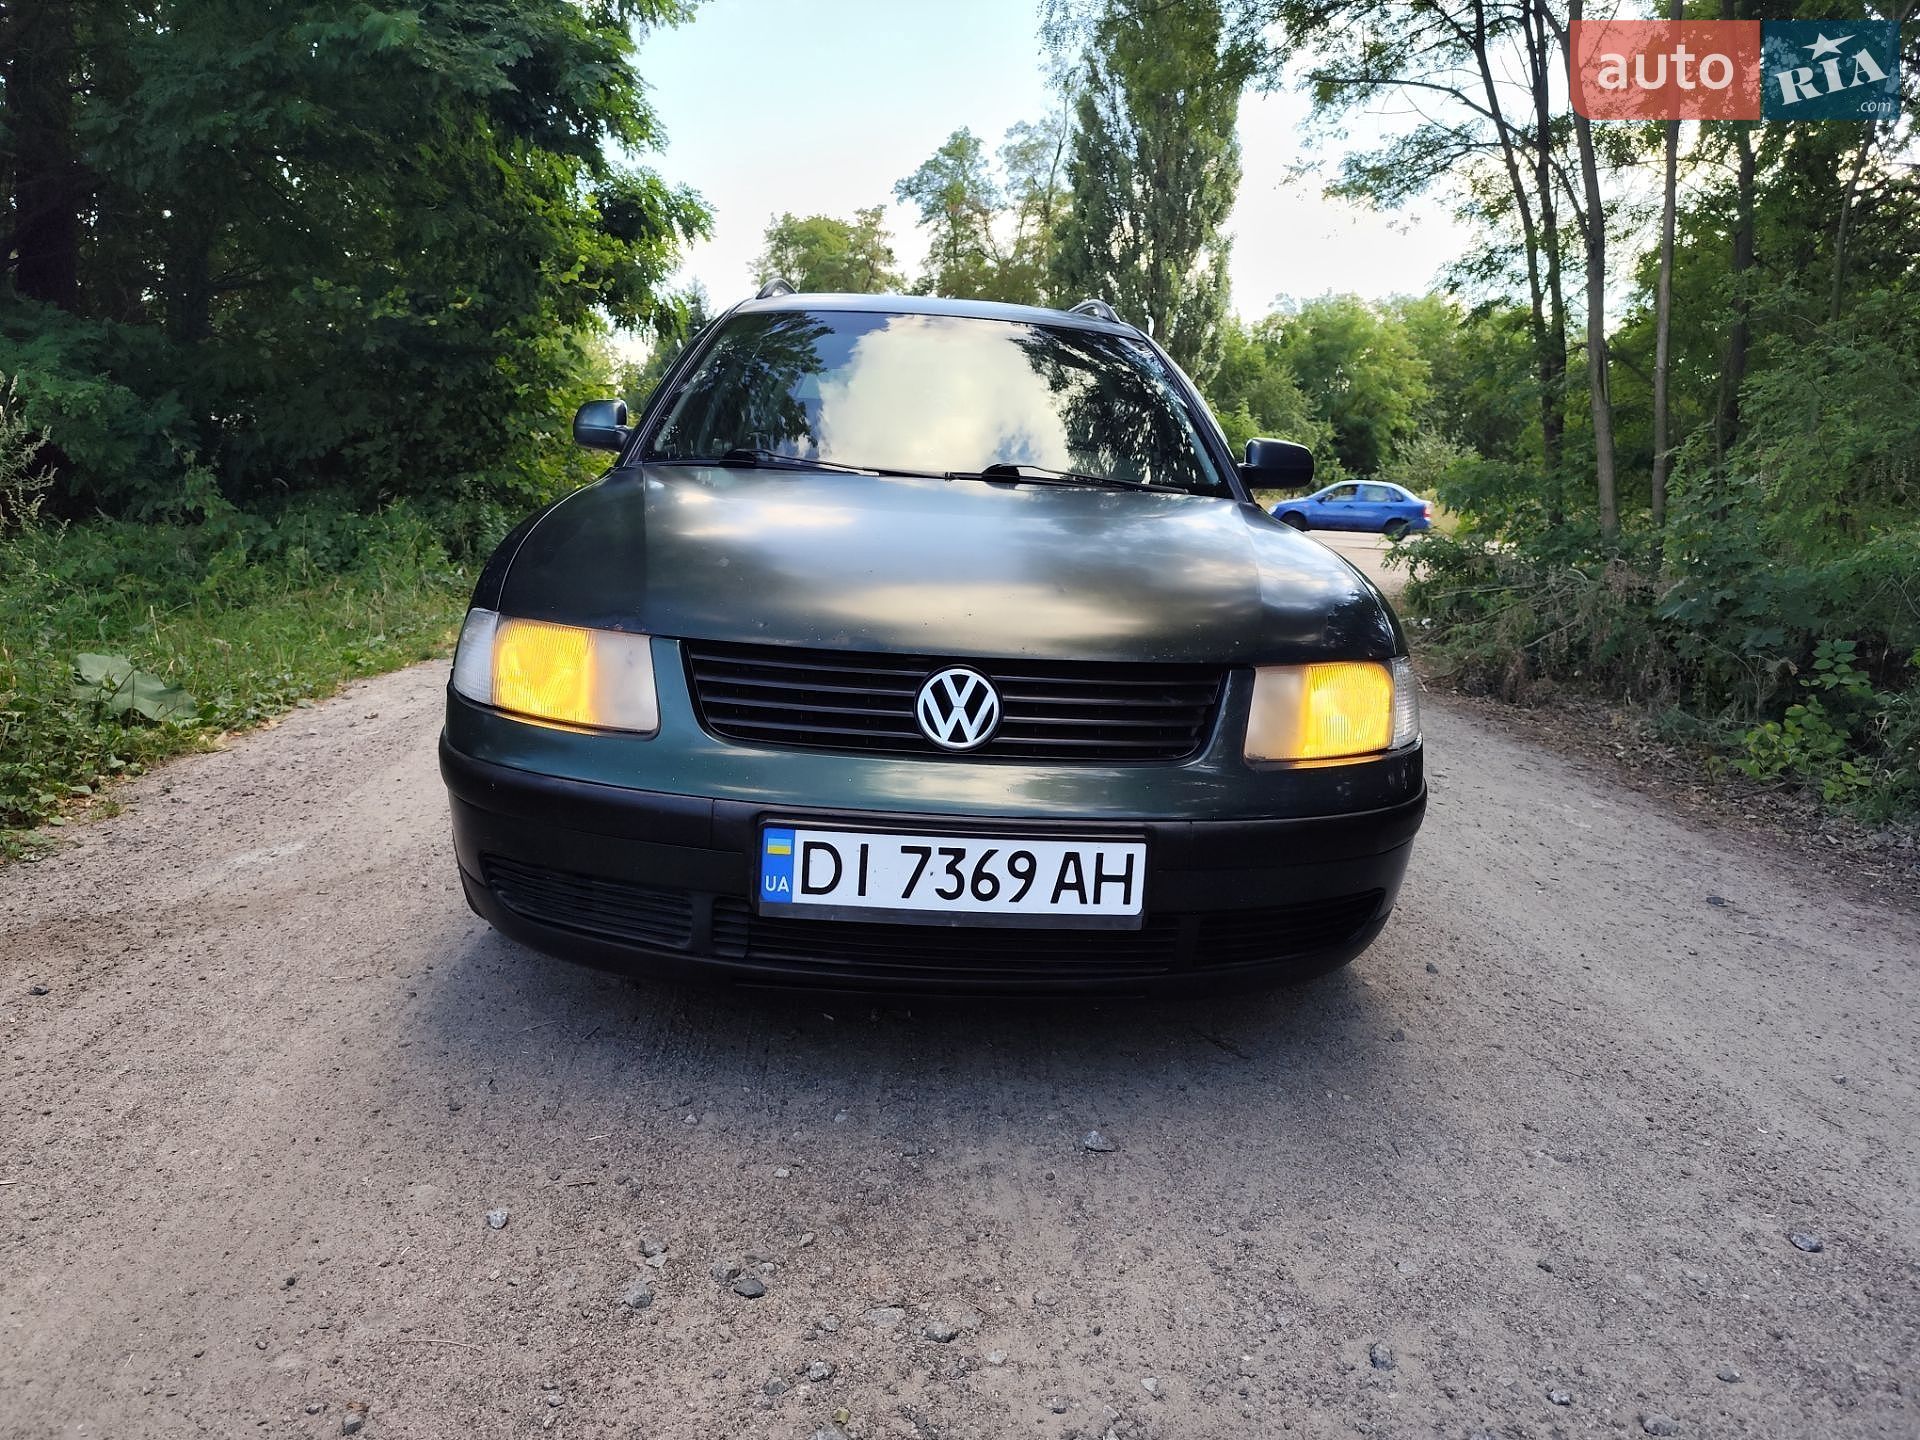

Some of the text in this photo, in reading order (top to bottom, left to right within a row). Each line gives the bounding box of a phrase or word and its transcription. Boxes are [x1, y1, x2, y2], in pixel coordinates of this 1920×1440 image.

[917, 668, 1000, 749] VW
[765, 875, 790, 893] UA
[800, 841, 1135, 905] DI 7369 AH
